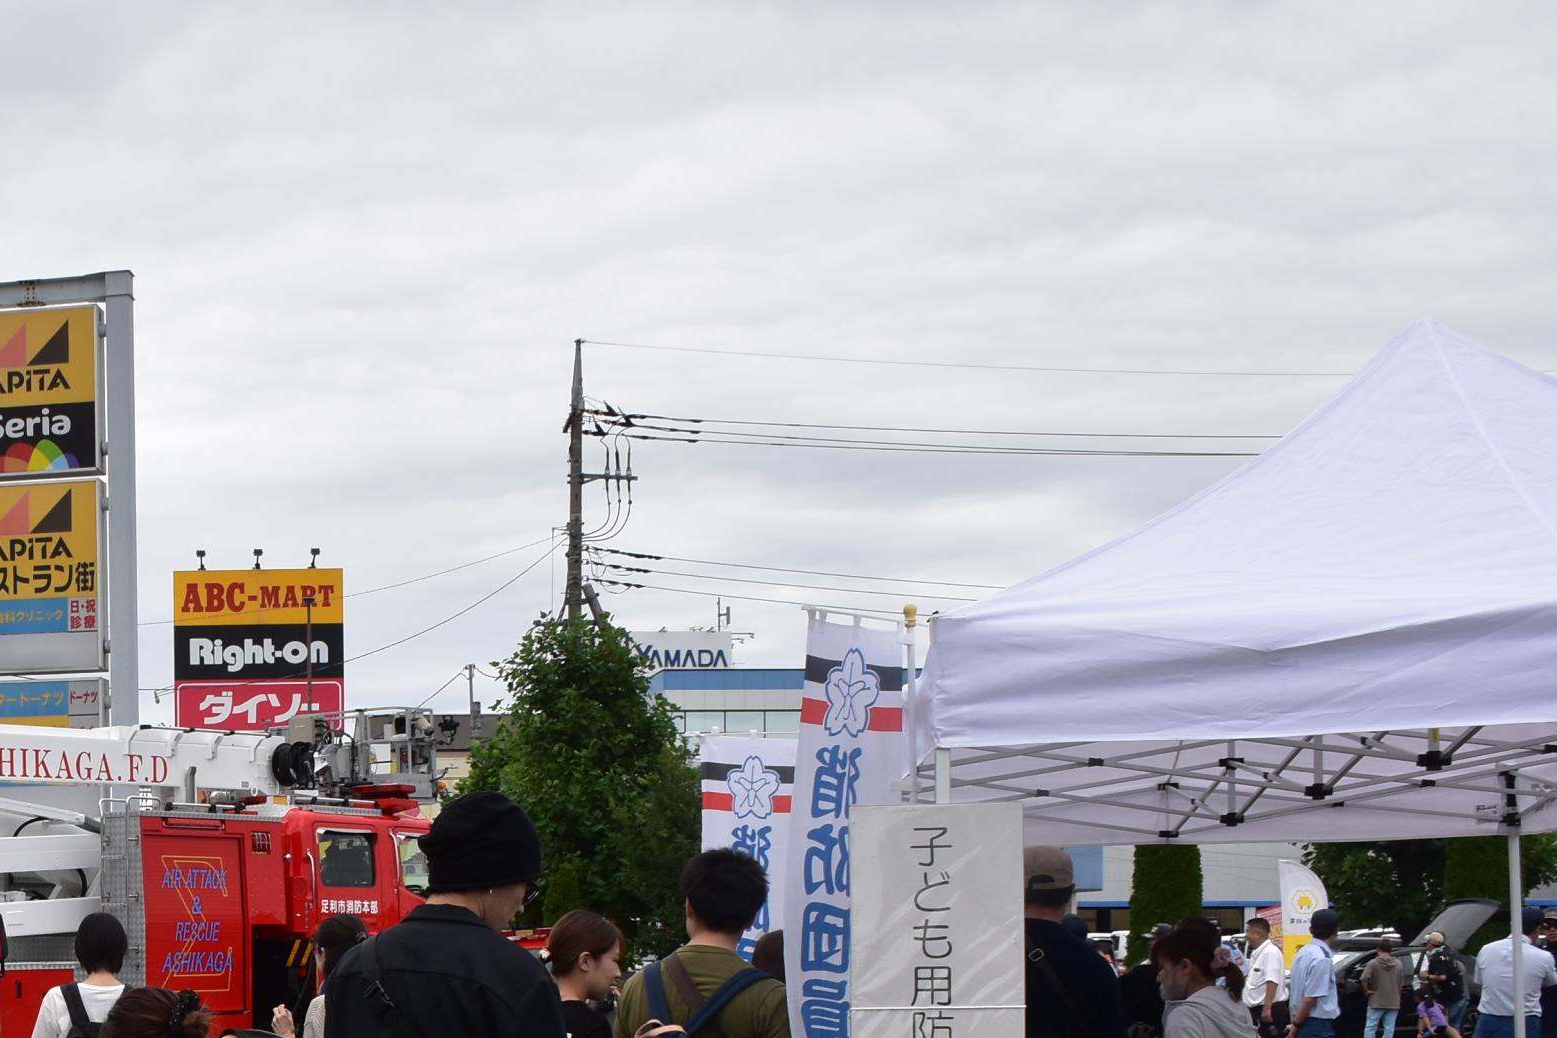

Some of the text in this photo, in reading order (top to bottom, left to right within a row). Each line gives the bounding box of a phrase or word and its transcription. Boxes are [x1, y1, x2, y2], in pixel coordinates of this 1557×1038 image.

[181, 582, 334, 612] ABC-MART
[70, 615, 96, 629] 診療
[189, 638, 329, 672] Right-on
[633, 643, 728, 667] YAMADA
[70, 690, 98, 704] ドーナツ
[199, 691, 320, 724] ダイソー
[162, 869, 228, 889] AIR ATTACK
[191, 895, 203, 915] &
[320, 899, 379, 915] 足利市消防本部
[175, 921, 220, 942] RESCUE
[162, 951, 233, 973] ASHIKAGA
